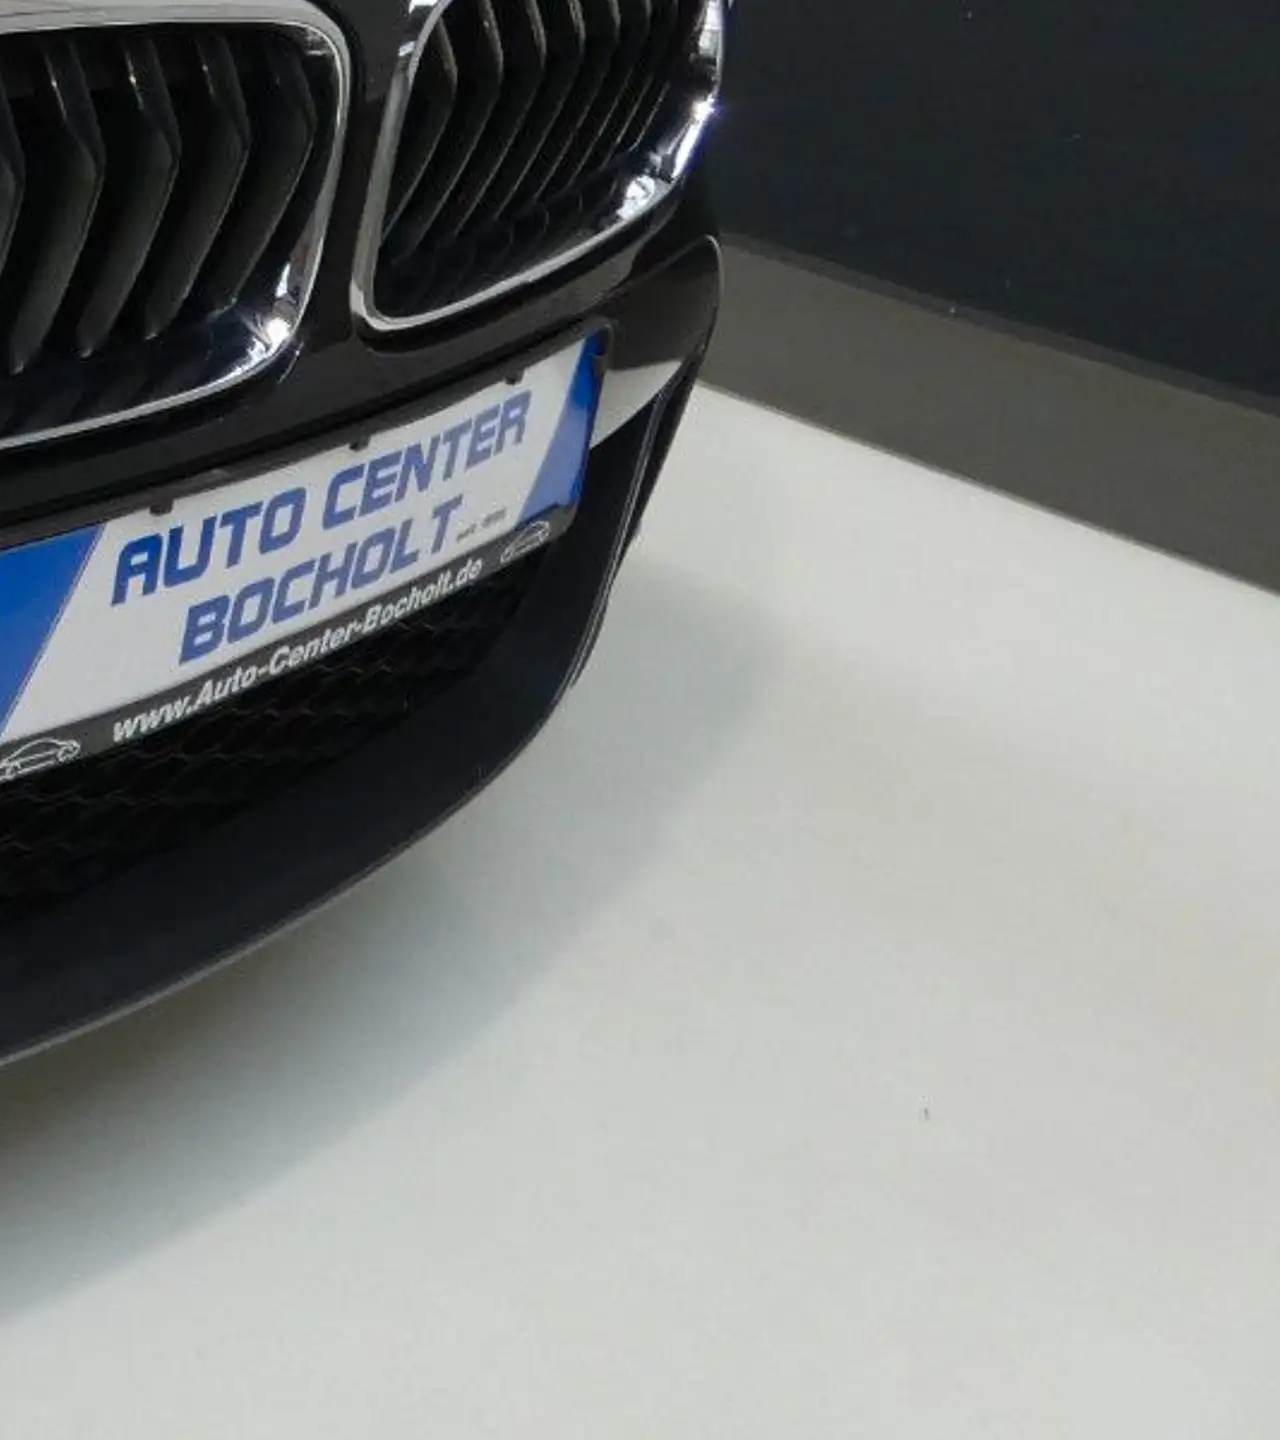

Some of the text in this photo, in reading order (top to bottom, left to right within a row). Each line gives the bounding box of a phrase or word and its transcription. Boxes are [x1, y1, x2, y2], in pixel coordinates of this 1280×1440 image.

[109, 389, 532, 607] AUTO CENTER
[178, 494, 463, 666] BOCHOLT
[112, 557, 483, 743] www.Auto-Center-Bocholt.de
